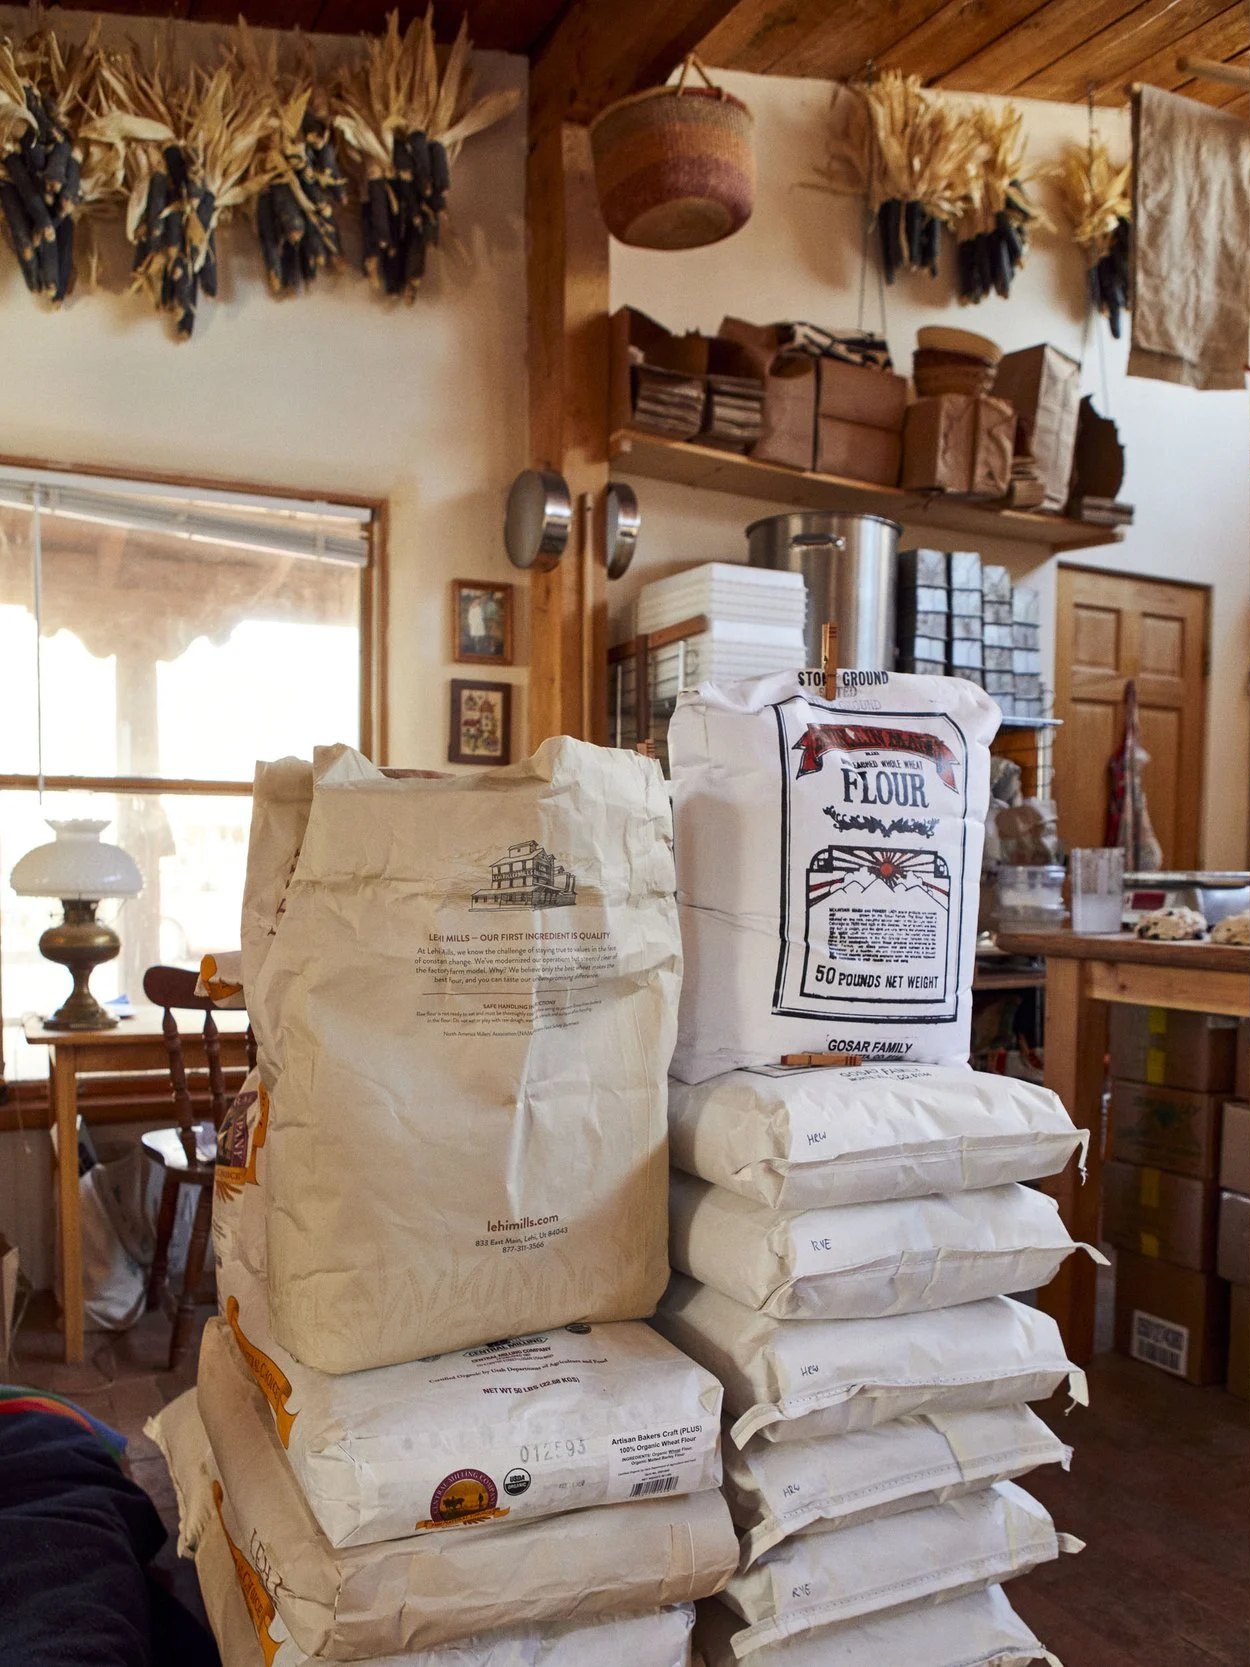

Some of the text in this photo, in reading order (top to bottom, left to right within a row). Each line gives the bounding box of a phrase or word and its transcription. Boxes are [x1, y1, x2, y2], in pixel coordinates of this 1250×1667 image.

[843, 672, 888, 686] GROUND
[881, 760, 901, 769] WHOLE
[903, 761, 923, 770] WHEAT
[841, 768, 930, 808] FLOUR
[446, 934, 470, 942] MILLS
[480, 934, 499, 942] OUR
[501, 933, 523, 941] FIRST
[525, 932, 569, 940] INGREDIENT
[579, 932, 610, 941] QUALITY
[497, 947, 526, 956] challenge
[528, 946, 534, 954] of
[423, 957, 447, 965] constan
[495, 956, 530, 964] modernized
[488, 966, 507, 975] Why?
[815, 964, 939, 989] 50 POUNDS NET WEIGHT
[477, 977, 489, 985] you
[828, 1039, 913, 1054] GOSAR FAMILY
[807, 1131, 827, 1146] HRW
[487, 1214, 559, 1233] lehimills.com
[505, 1237, 523, 1245] Main,
[524, 1234, 538, 1243] Lehi,
[548, 1227, 568, 1238] 84043
[502, 1242, 545, 1253] 877-311-3566
[811, 1238, 832, 1252] RYE
[523, 1346, 551, 1354] COMPANY
[523, 1385, 539, 1393] LBS
[540, 1378, 561, 1388] (22.68
[612, 1425, 702, 1446] Artisan Bakers Craft (PLUS)
[637, 1443, 660, 1451] Organic
[661, 1439, 680, 1447] Wheat
[449, 1471, 478, 1482] MILLING
[509, 1474, 525, 1482] USDA
[792, 1583, 811, 1598] RYE
